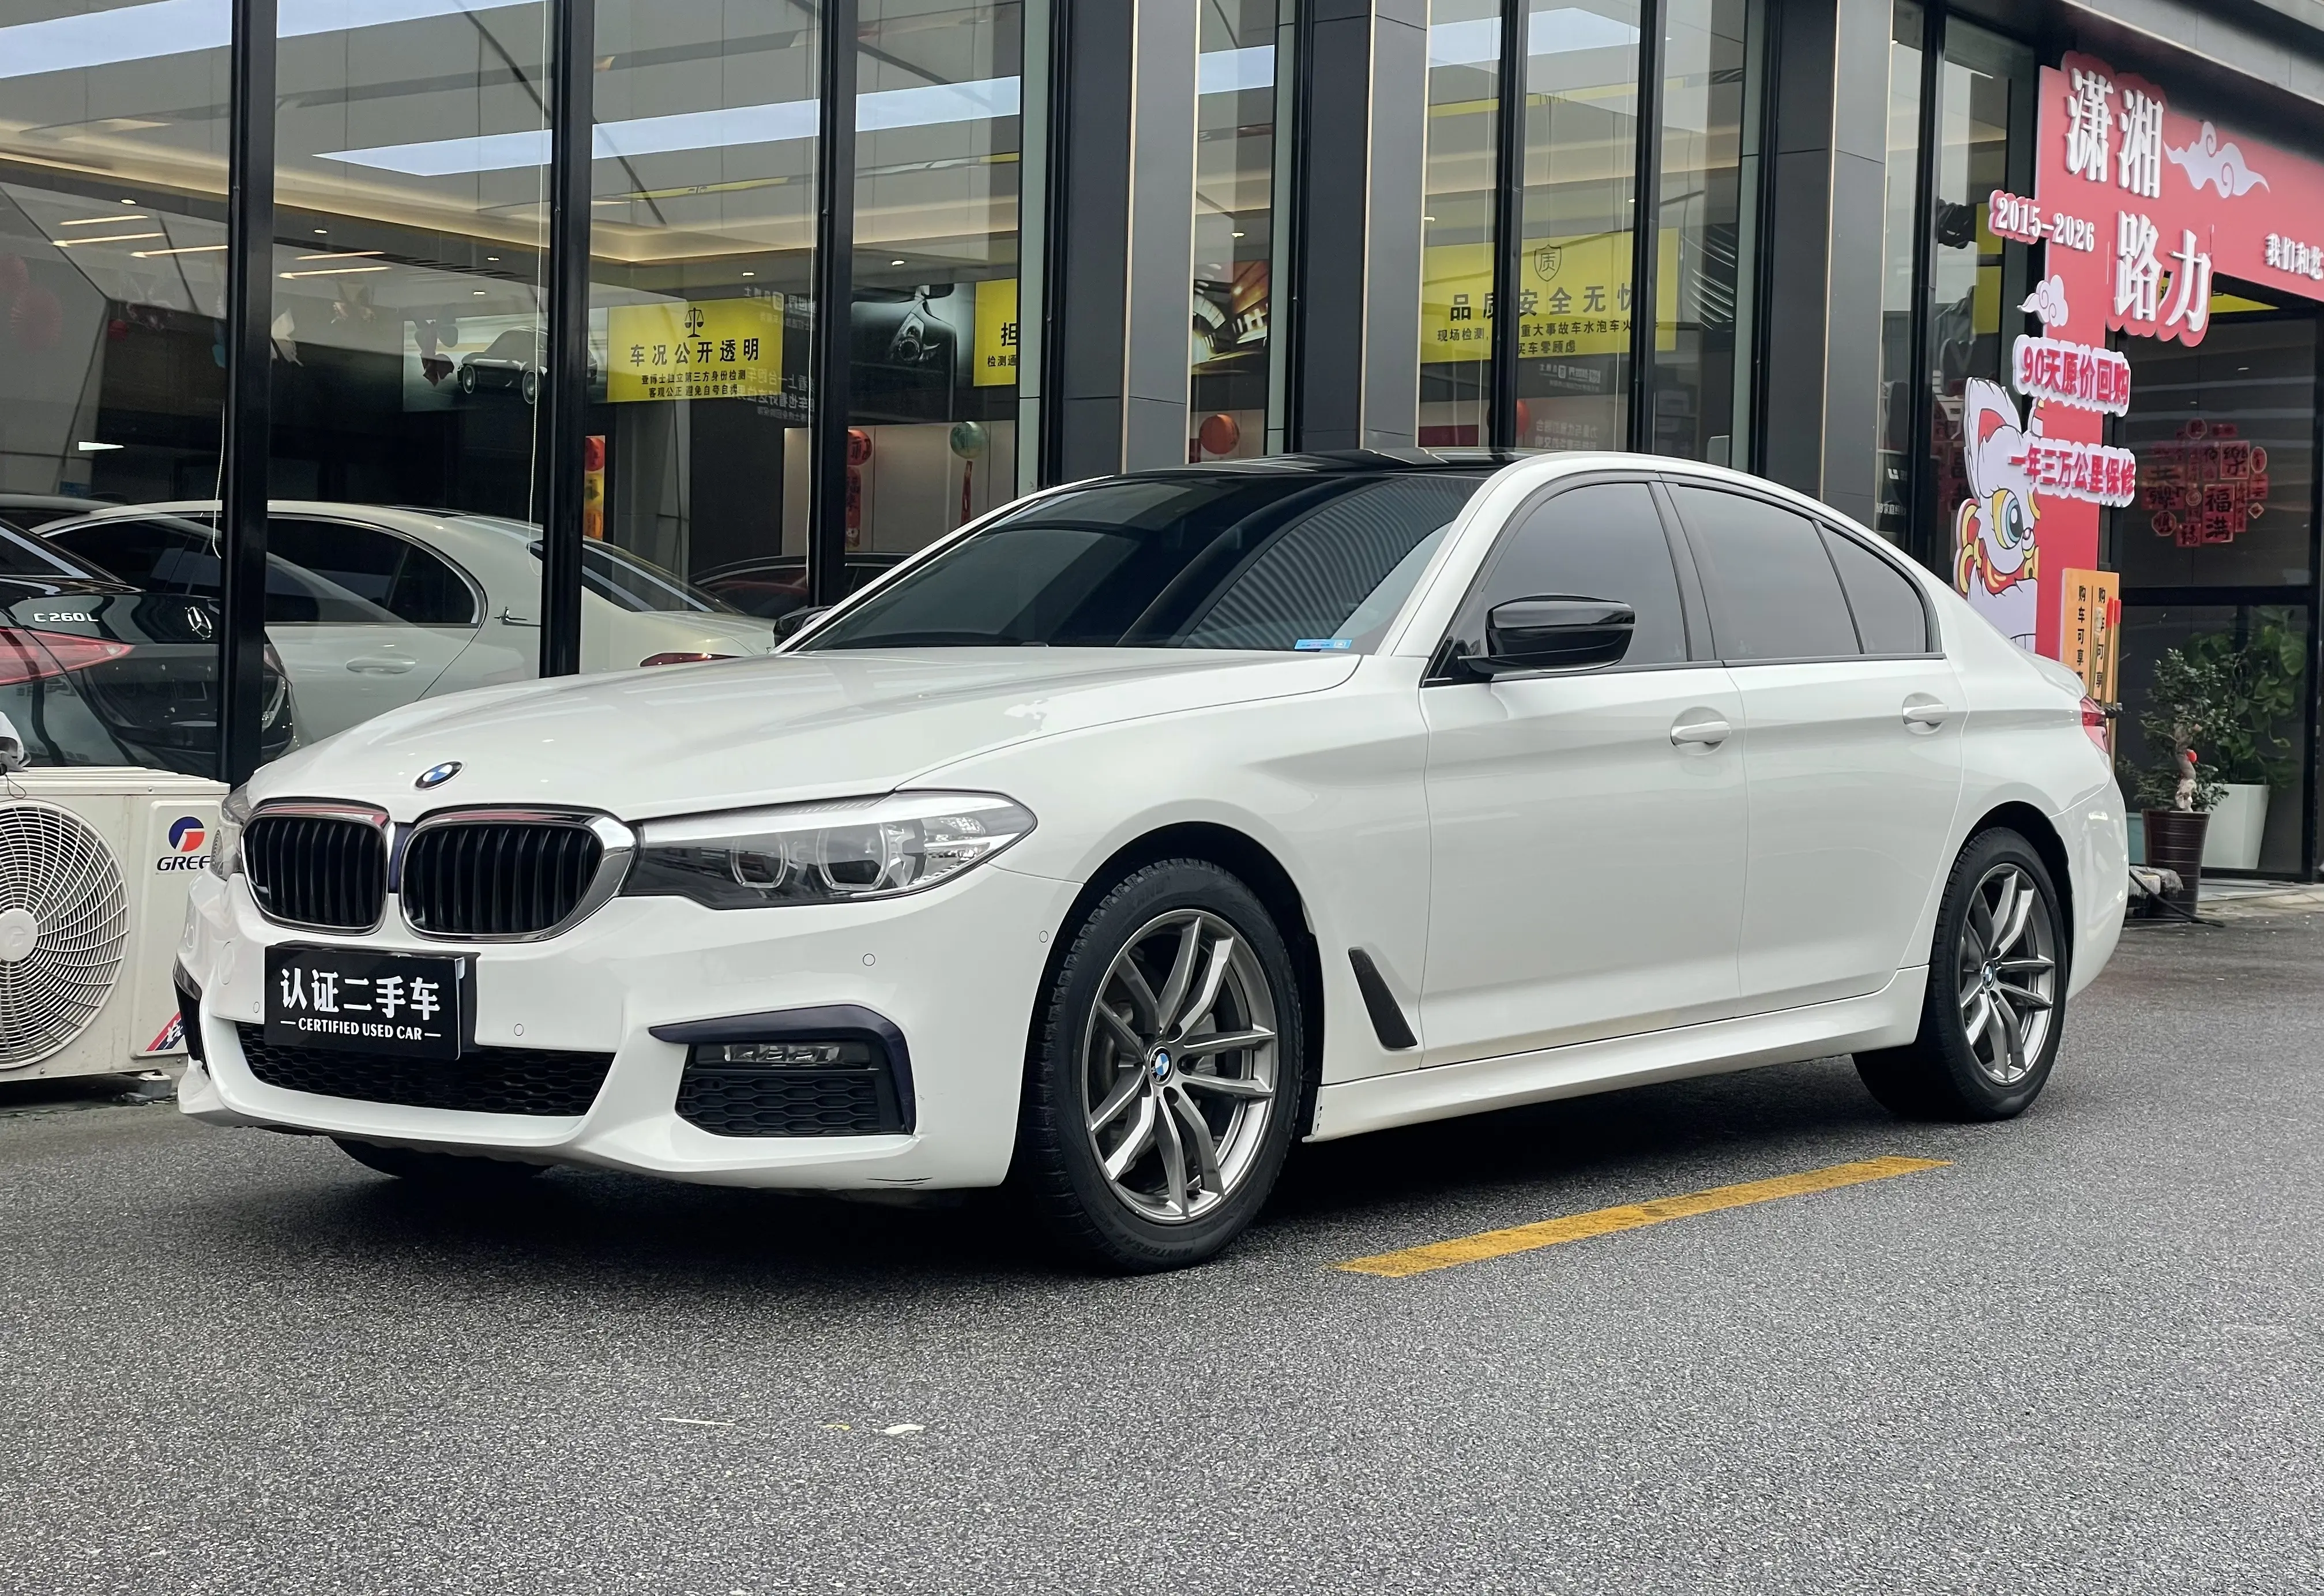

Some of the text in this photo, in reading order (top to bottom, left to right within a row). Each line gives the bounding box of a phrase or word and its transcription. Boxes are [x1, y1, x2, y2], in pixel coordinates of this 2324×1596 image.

[2065, 67, 2165, 199] 潇湘
[1995, 197, 2094, 252] 2015-2026
[1539, 251, 1555, 272] 质
[2114, 210, 2212, 333] 路力
[630, 338, 759, 367] 车况公开透明
[1001, 322, 1017, 347] 担
[2021, 346, 2130, 406] 90天原价回购
[2010, 443, 2135, 497] 一年三万公里保修
[156, 855, 210, 871] GREE
[280, 967, 440, 1020] 认证二手车
[298, 1017, 422, 1041] CERTIFIED USED CAR
